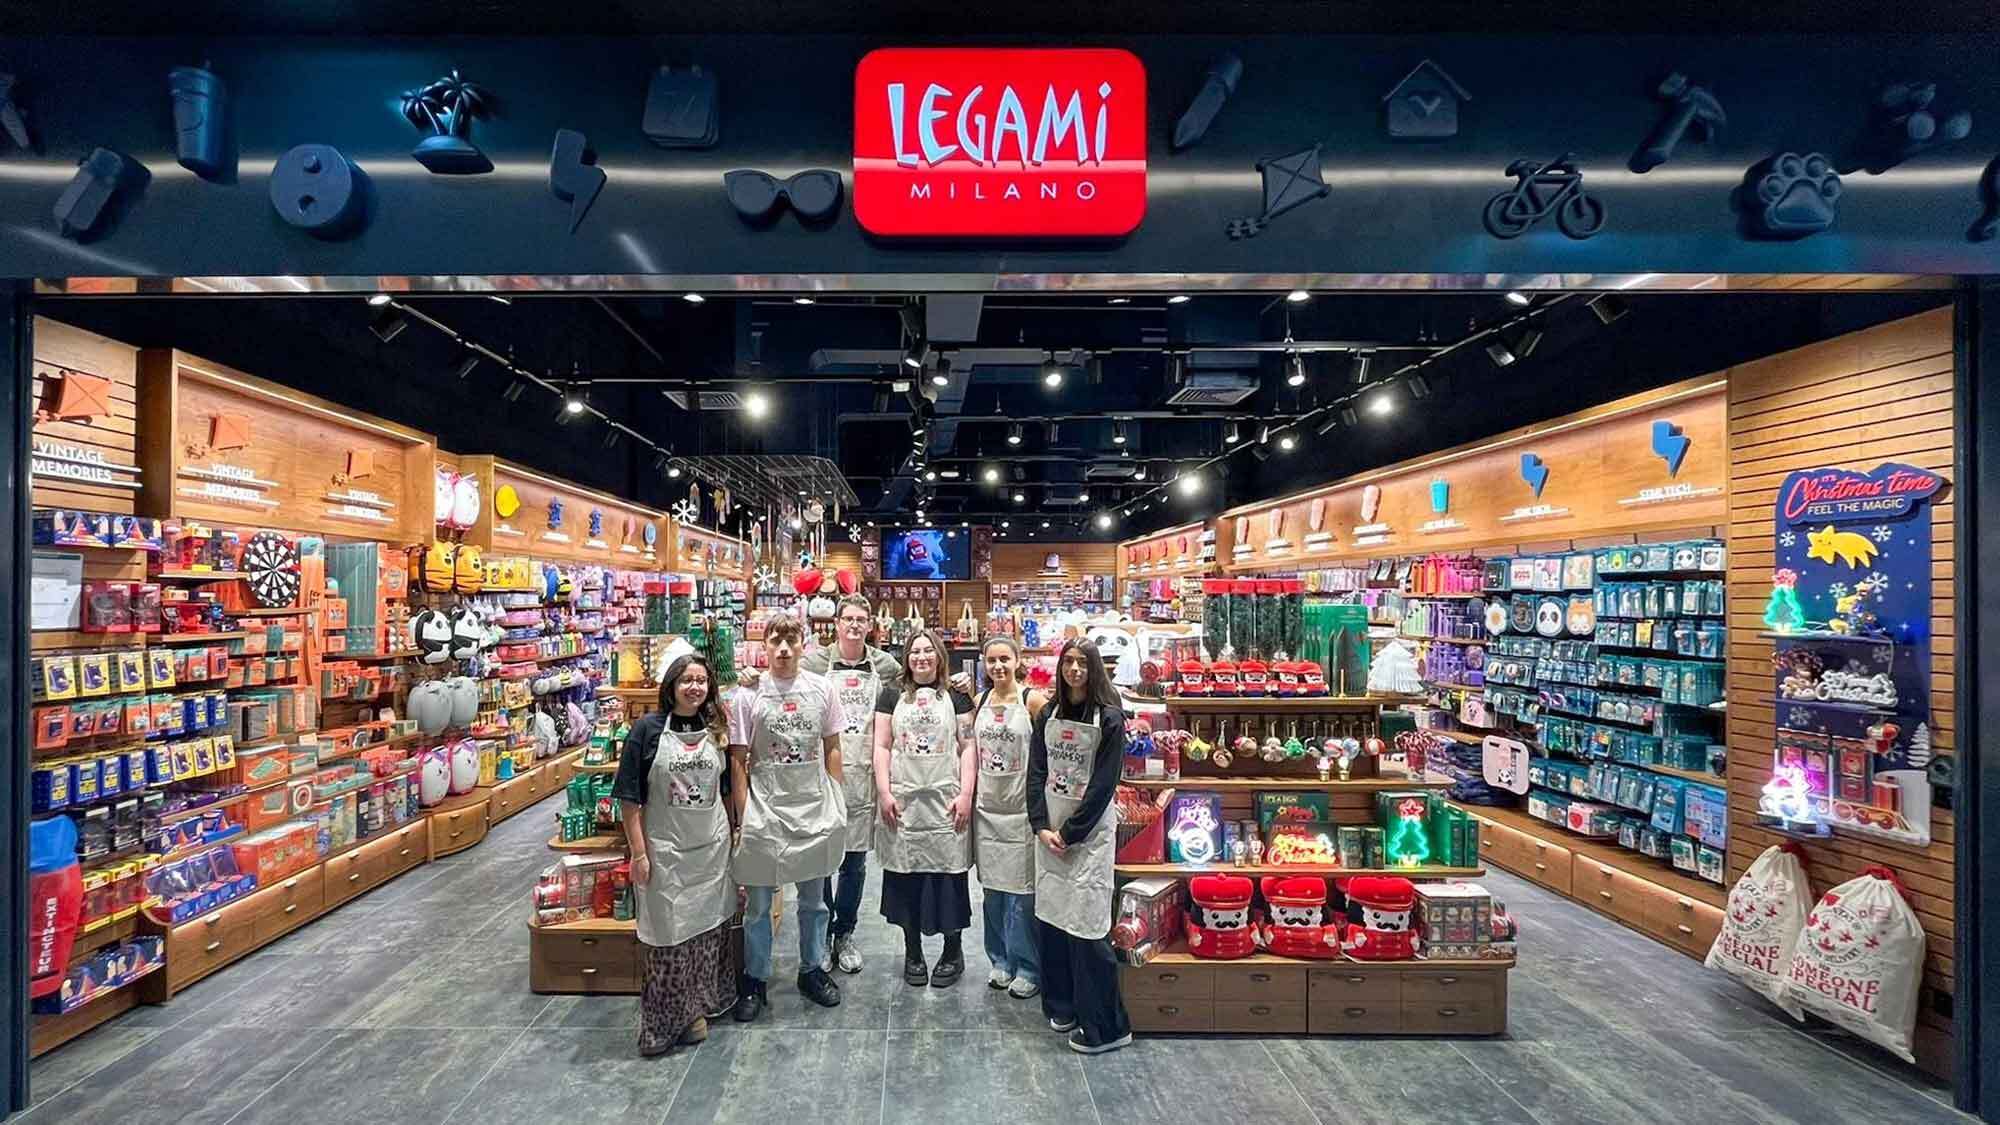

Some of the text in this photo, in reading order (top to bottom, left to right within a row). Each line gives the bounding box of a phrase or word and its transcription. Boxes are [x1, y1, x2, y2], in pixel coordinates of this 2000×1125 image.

[910, 182, 1096, 199] MILANO
[39, 442, 105, 463] VINTAGE
[31, 459, 113, 481] MEMORIES
[1785, 470, 1937, 518] Christmas time
[1808, 498, 1905, 515] FEEL THE MAGIC
